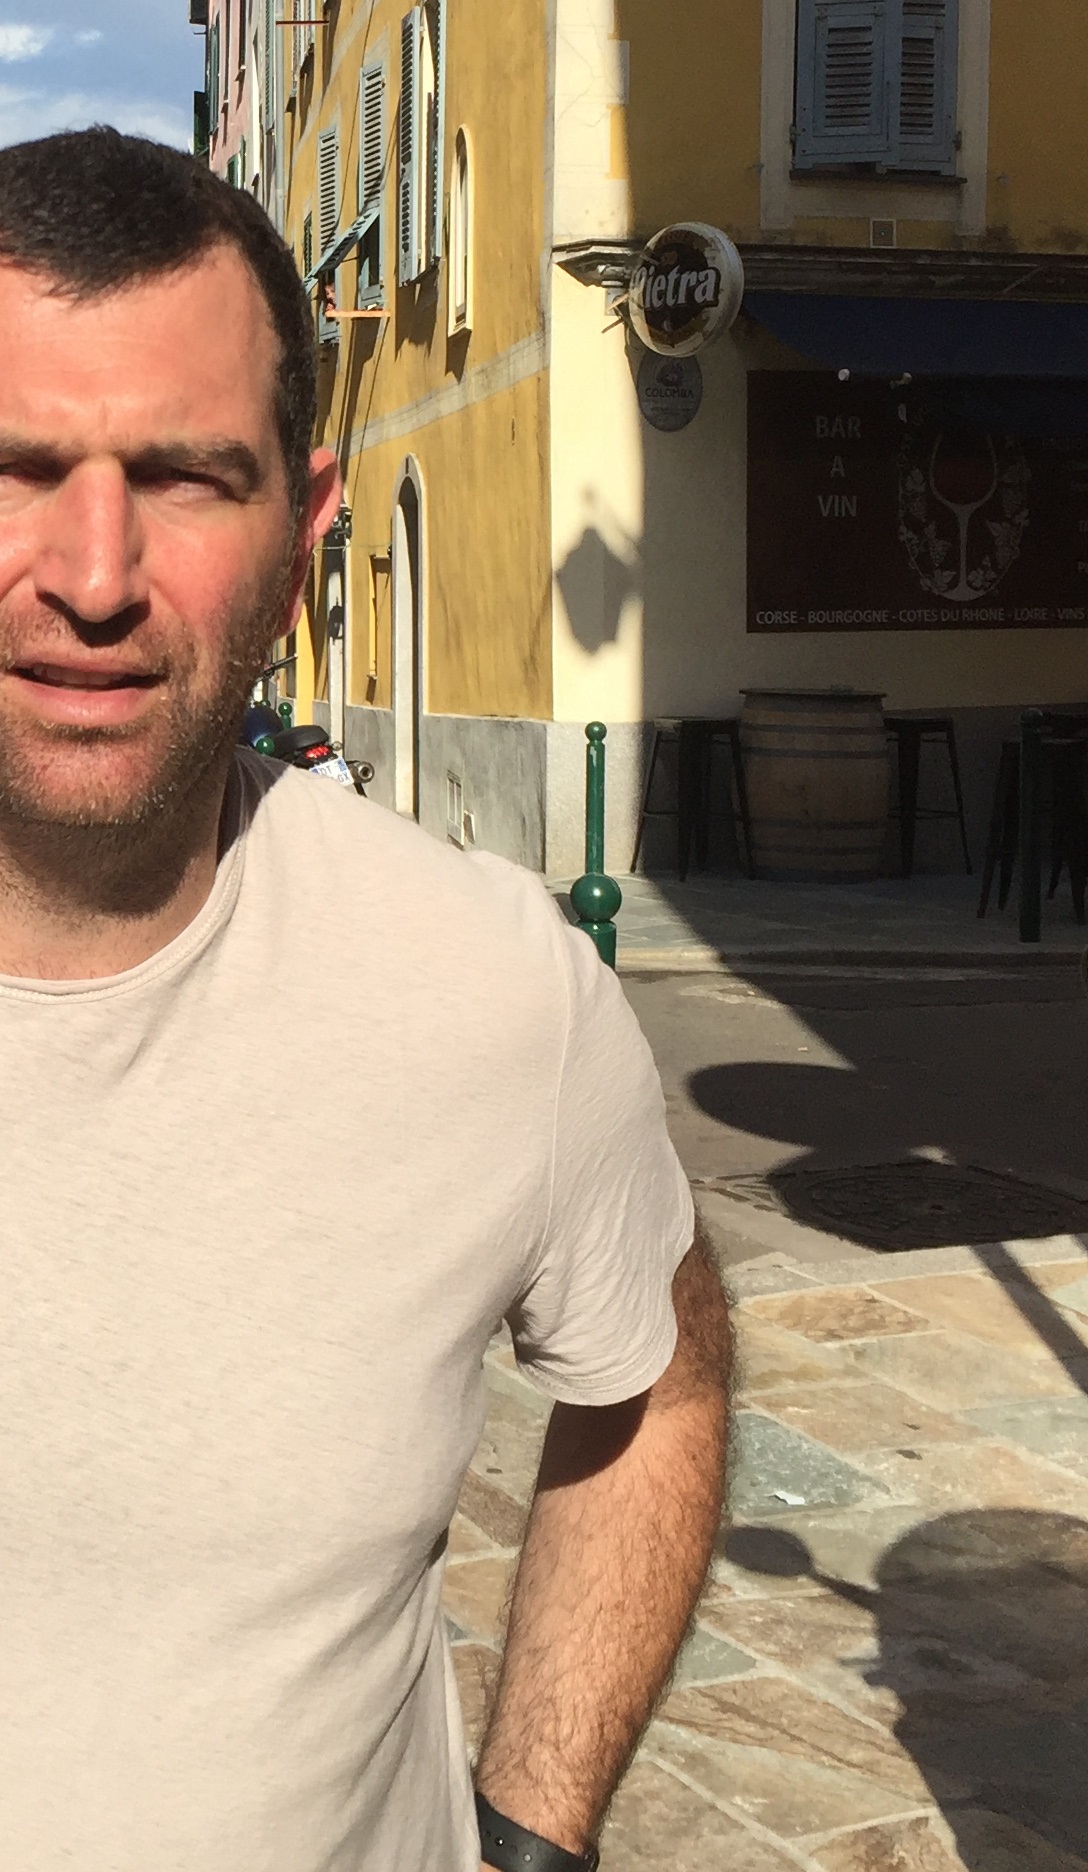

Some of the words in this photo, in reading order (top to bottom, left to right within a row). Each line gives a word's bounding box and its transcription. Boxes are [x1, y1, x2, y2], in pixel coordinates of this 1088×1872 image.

[632, 264, 718, 309] Pietra
[644, 387, 695, 399] COLOMBA
[814, 415, 862, 439] BAR
[829, 455, 847, 478] A
[817, 494, 858, 518] VIN
[755, 610, 798, 624] CORSE
[807, 609, 889, 623] BOURGOGNE
[899, 609, 939, 623] COTES
[941, 608, 960, 622] DU
[962, 608, 1005, 621] RHONE
[1014, 607, 1048, 621] LOIRE
[1057, 607, 1086, 620] VINS
